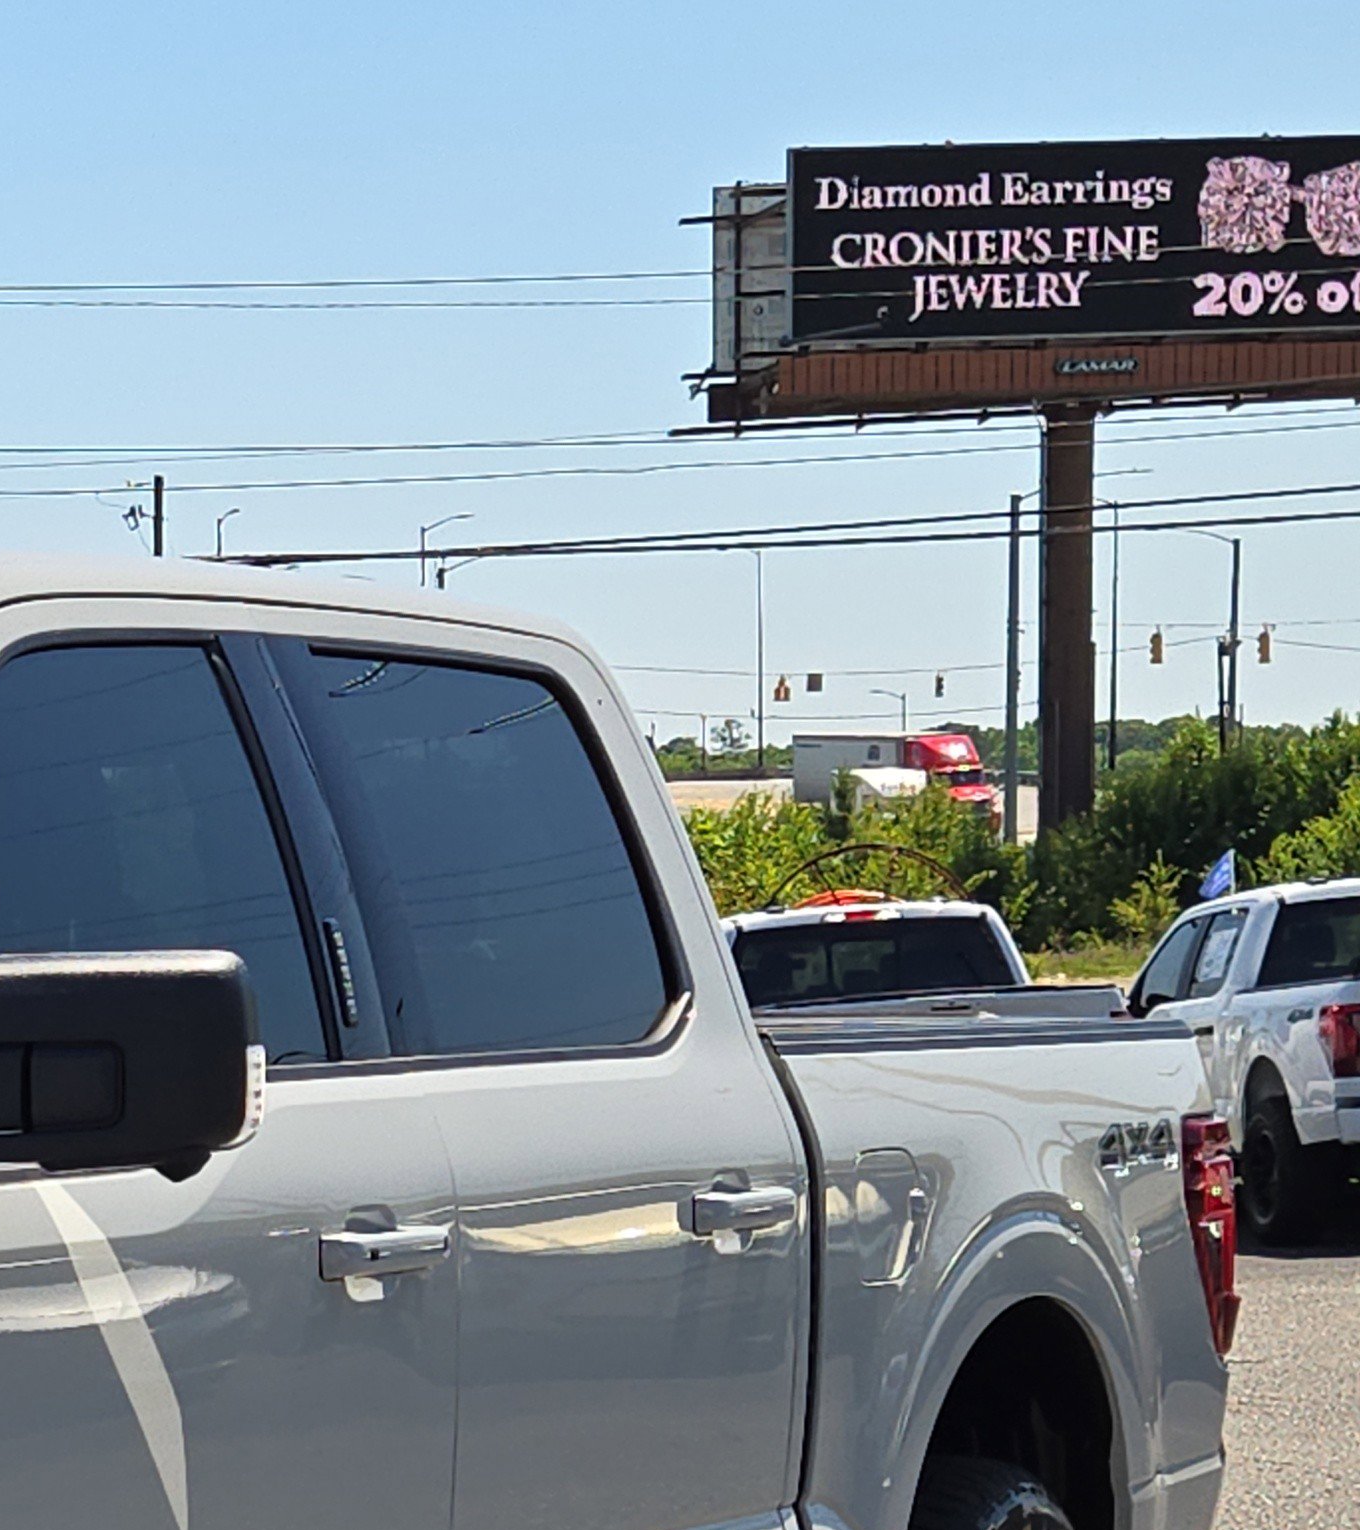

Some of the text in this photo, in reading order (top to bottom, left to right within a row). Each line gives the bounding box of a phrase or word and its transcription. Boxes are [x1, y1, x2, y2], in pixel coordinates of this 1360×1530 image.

[813, 169, 1174, 210] Diamond Earrings
[830, 225, 1160, 269] CRONIER'S FINE
[908, 269, 1091, 321] JEWELRY
[1192, 270, 1308, 317] 20%
